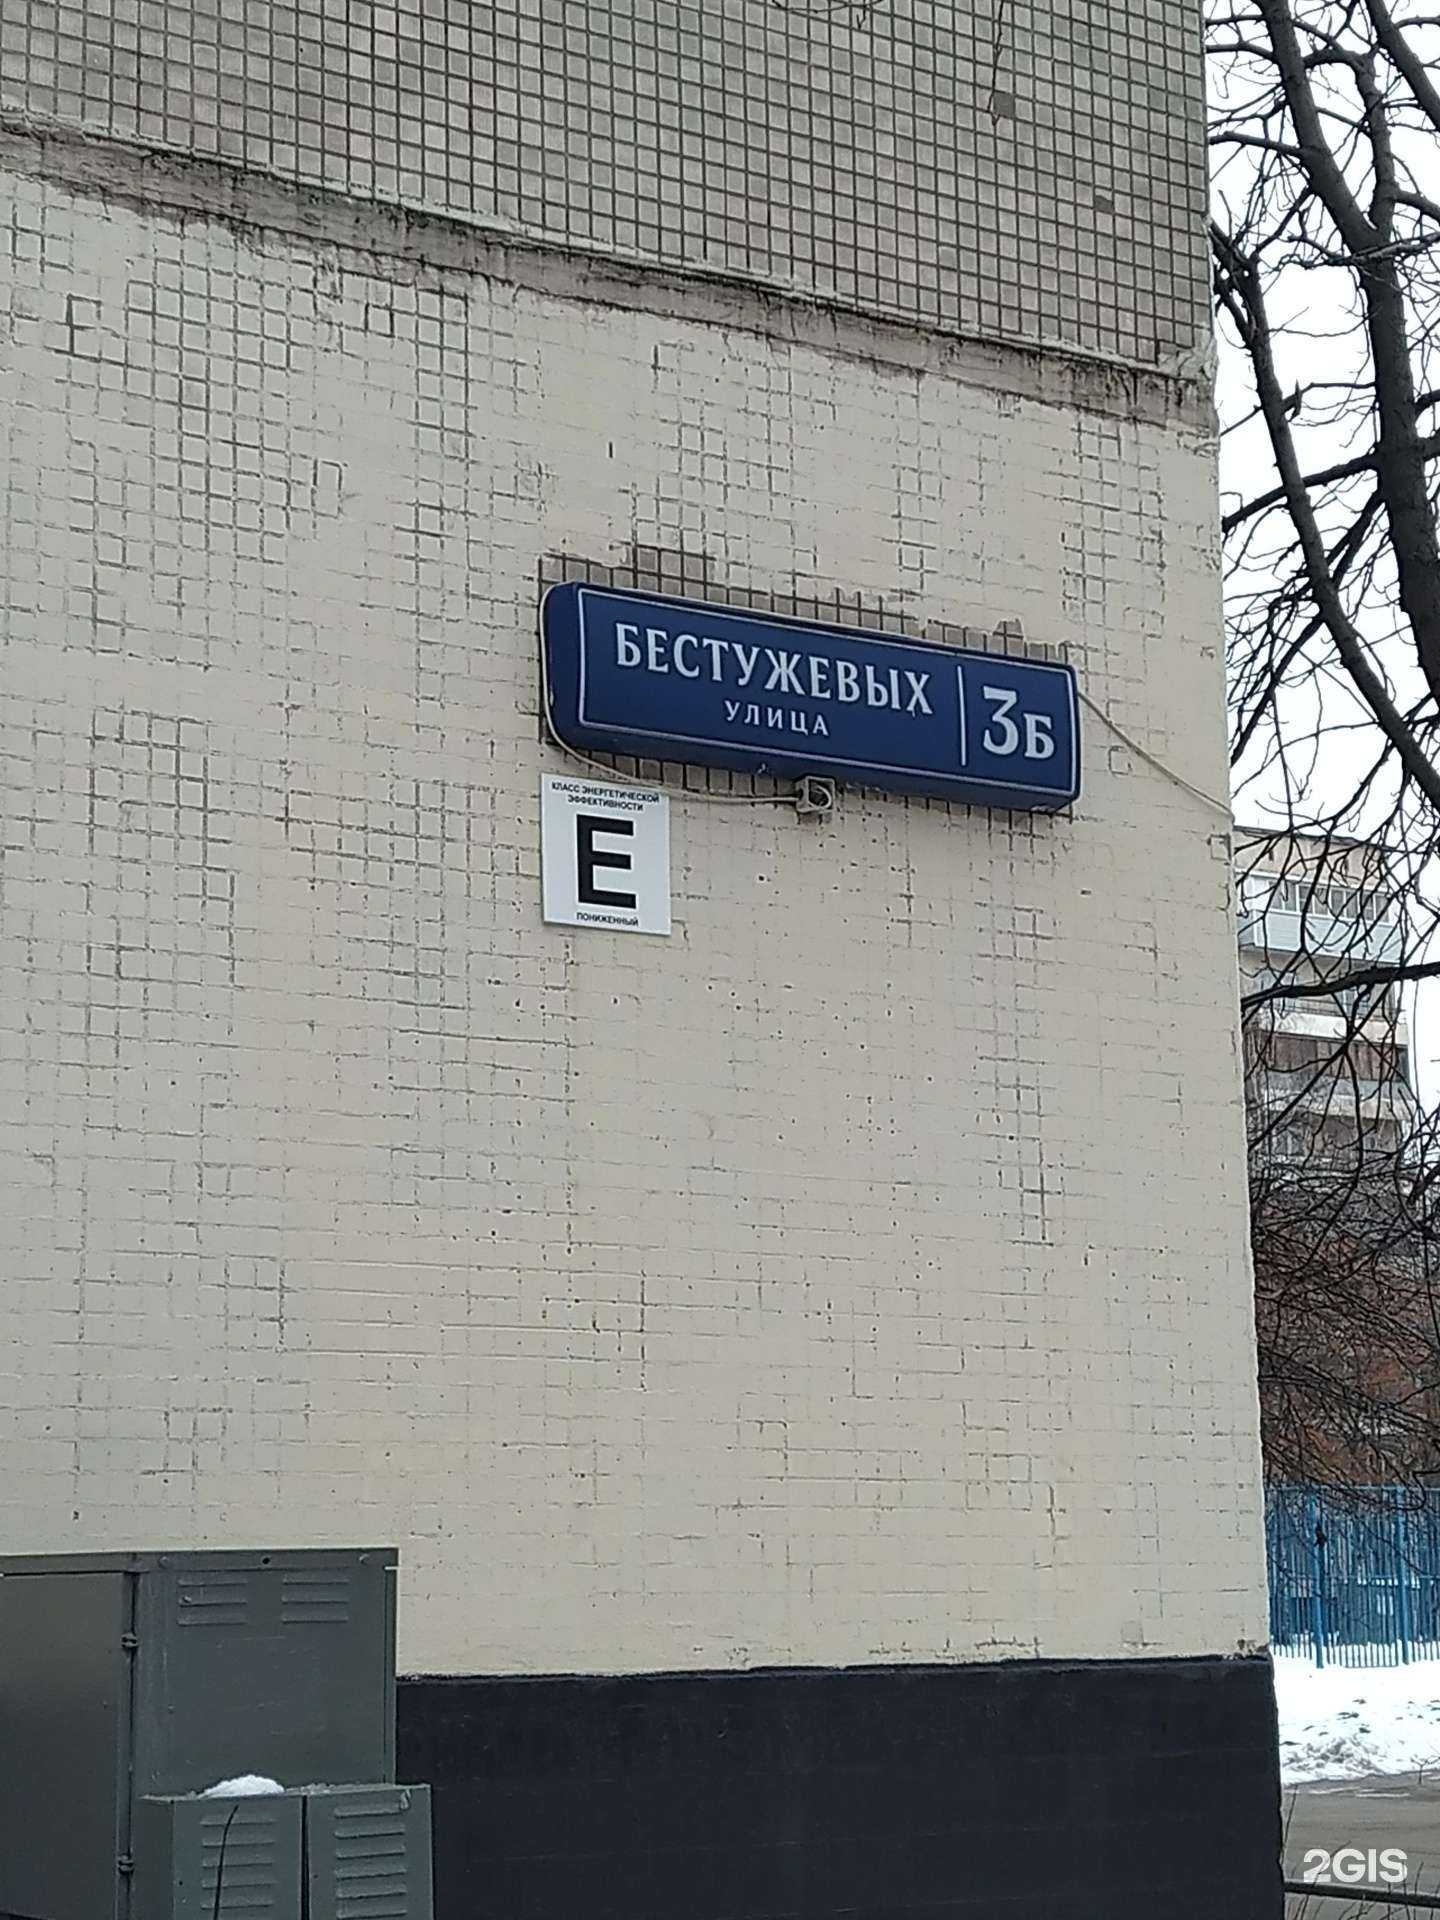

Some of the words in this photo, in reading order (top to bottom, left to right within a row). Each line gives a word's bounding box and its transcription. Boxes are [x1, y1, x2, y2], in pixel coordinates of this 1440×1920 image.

[615, 622, 933, 716] БЕСТУЖЕВЫХ
[724, 700, 830, 737] УЛИЦА
[982, 685, 1055, 759] 3Б
[551, 781, 580, 793] КЛАСС
[582, 784, 660, 803] ЭНЕРГЕТИЧЕСКОЙ
[567, 795, 644, 811] ЭФФЕКТИВНОСТИ
[576, 814, 637, 909] Е
[576, 912, 639, 926] ПОНИЖЕННЫЙ
